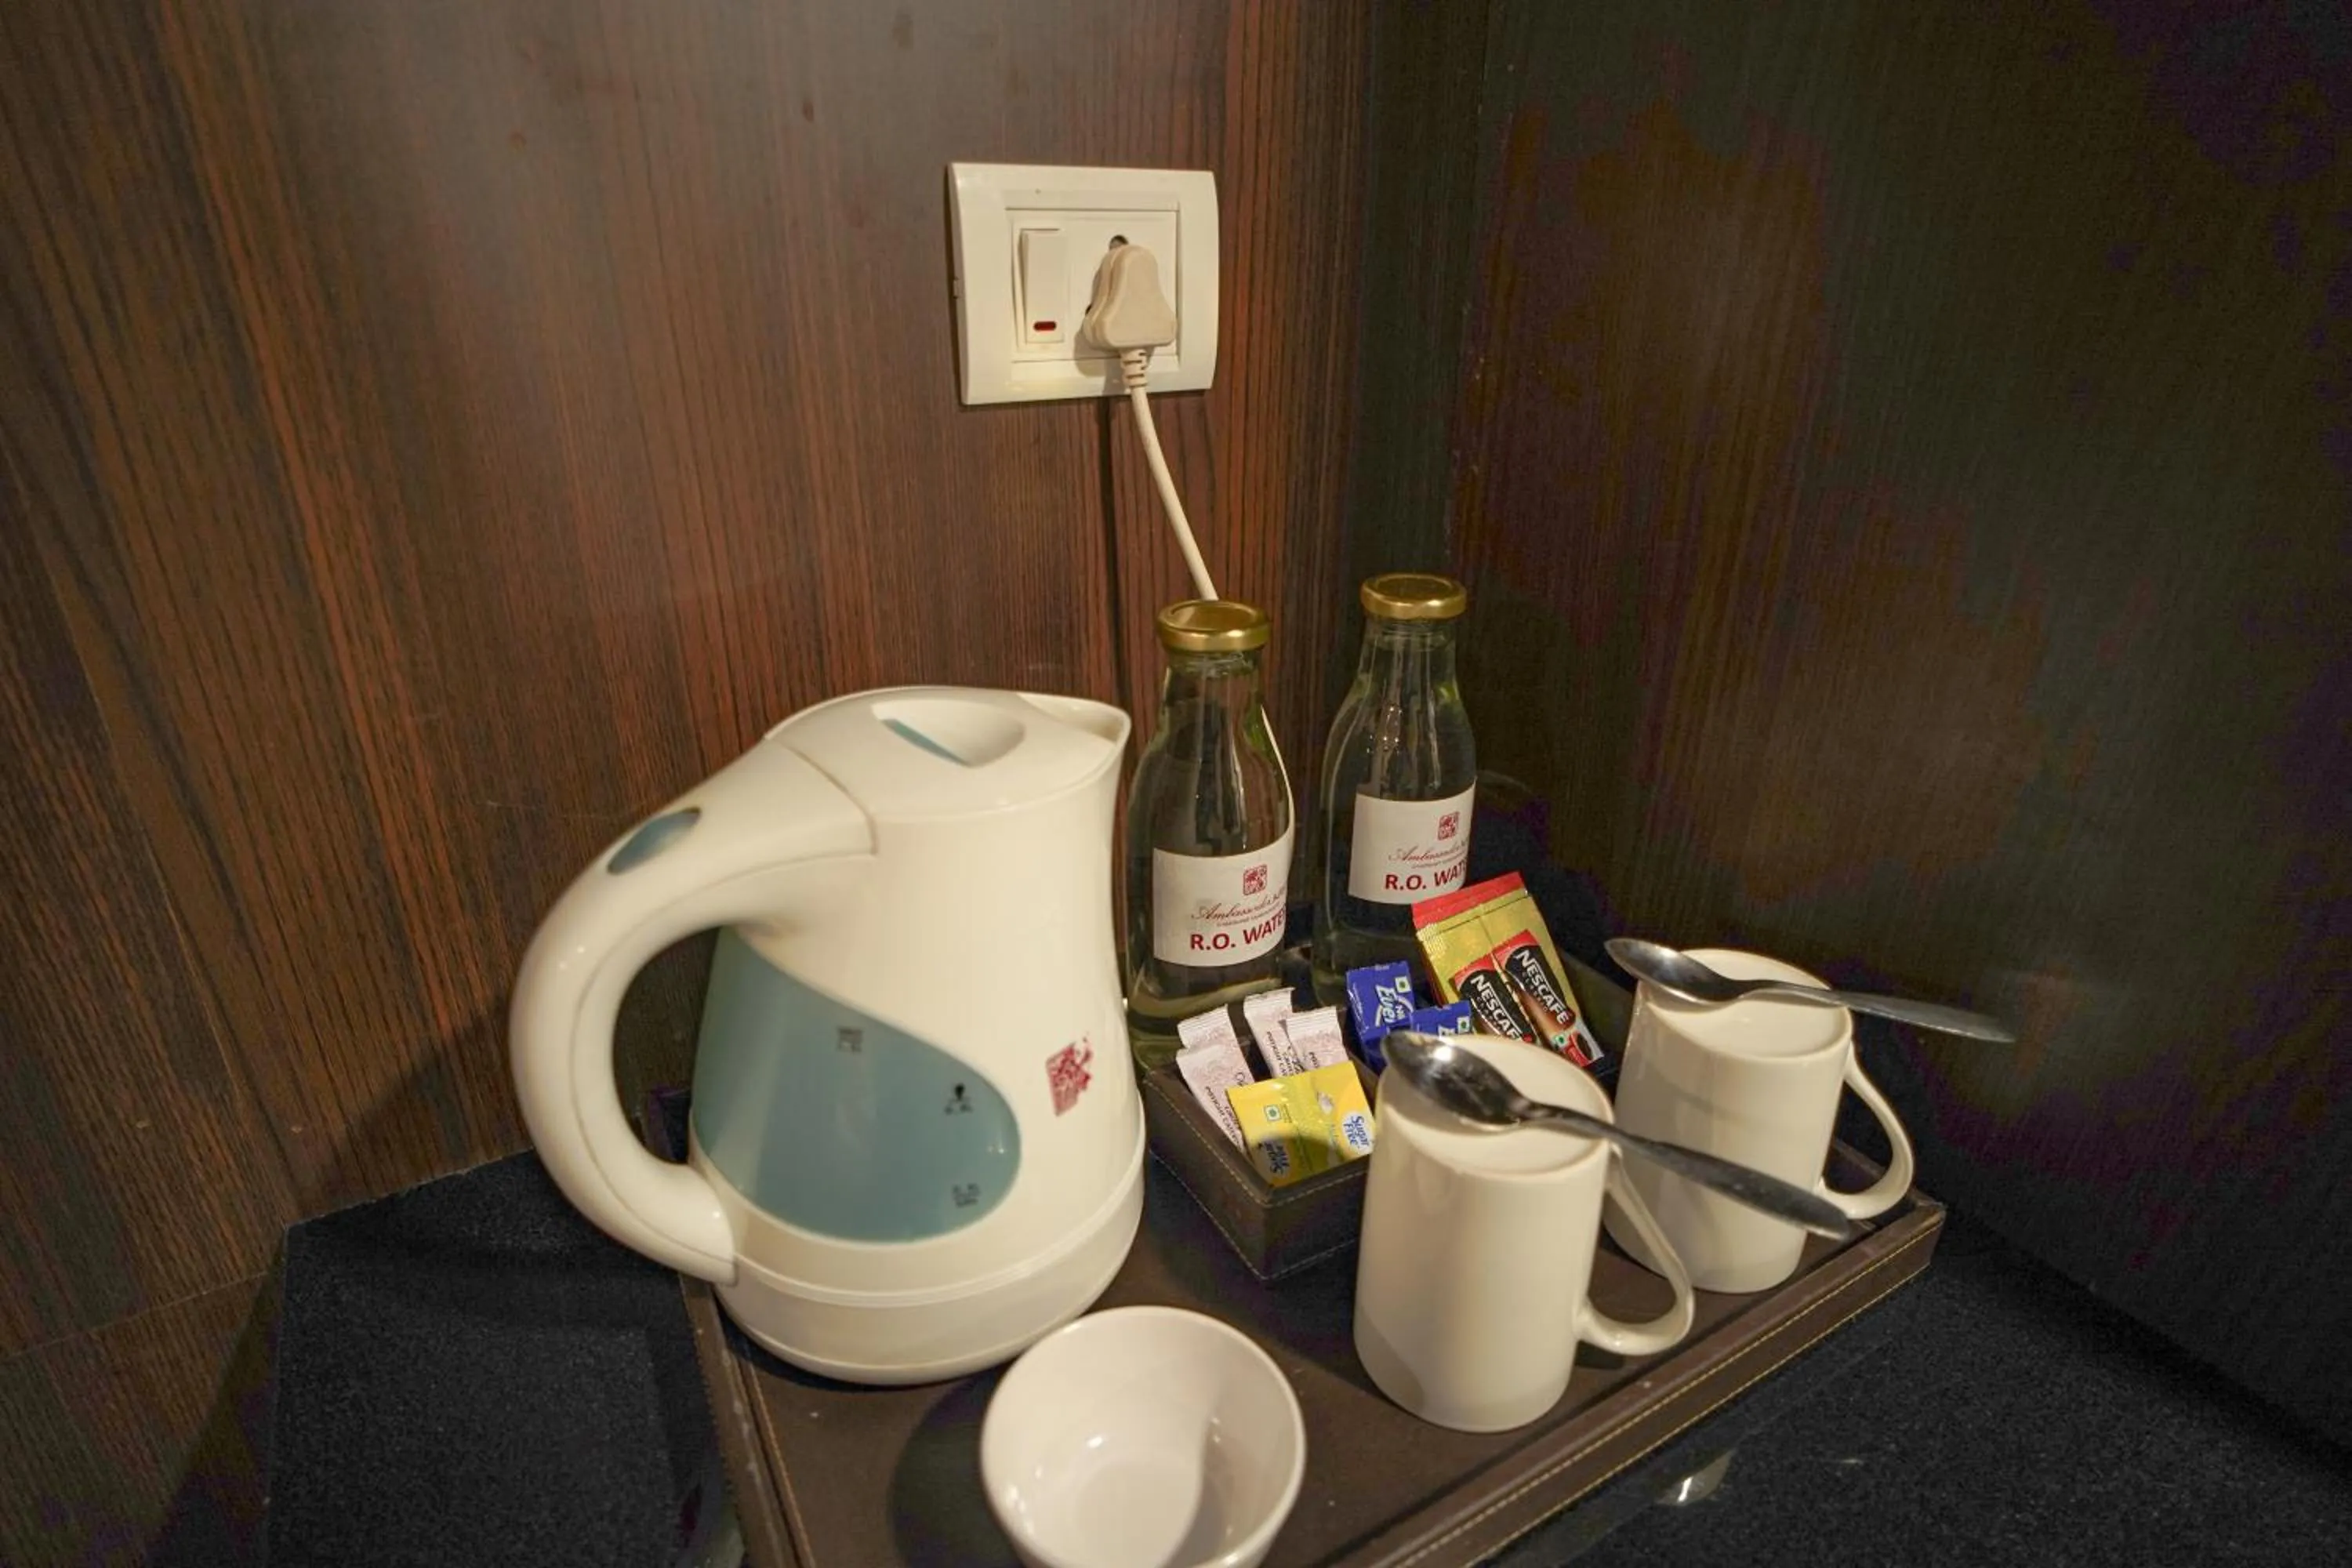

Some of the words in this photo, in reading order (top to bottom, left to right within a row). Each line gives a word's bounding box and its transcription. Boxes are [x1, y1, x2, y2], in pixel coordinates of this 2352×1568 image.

[1385, 874, 1427, 891] R.O.
[1433, 859, 1467, 887] WAT
[1189, 932, 1236, 951] R.O.
[1243, 903, 1287, 945] WATE
[1470, 974, 1524, 1041] NESCAF
[1349, 1115, 1370, 1146] Sugar
